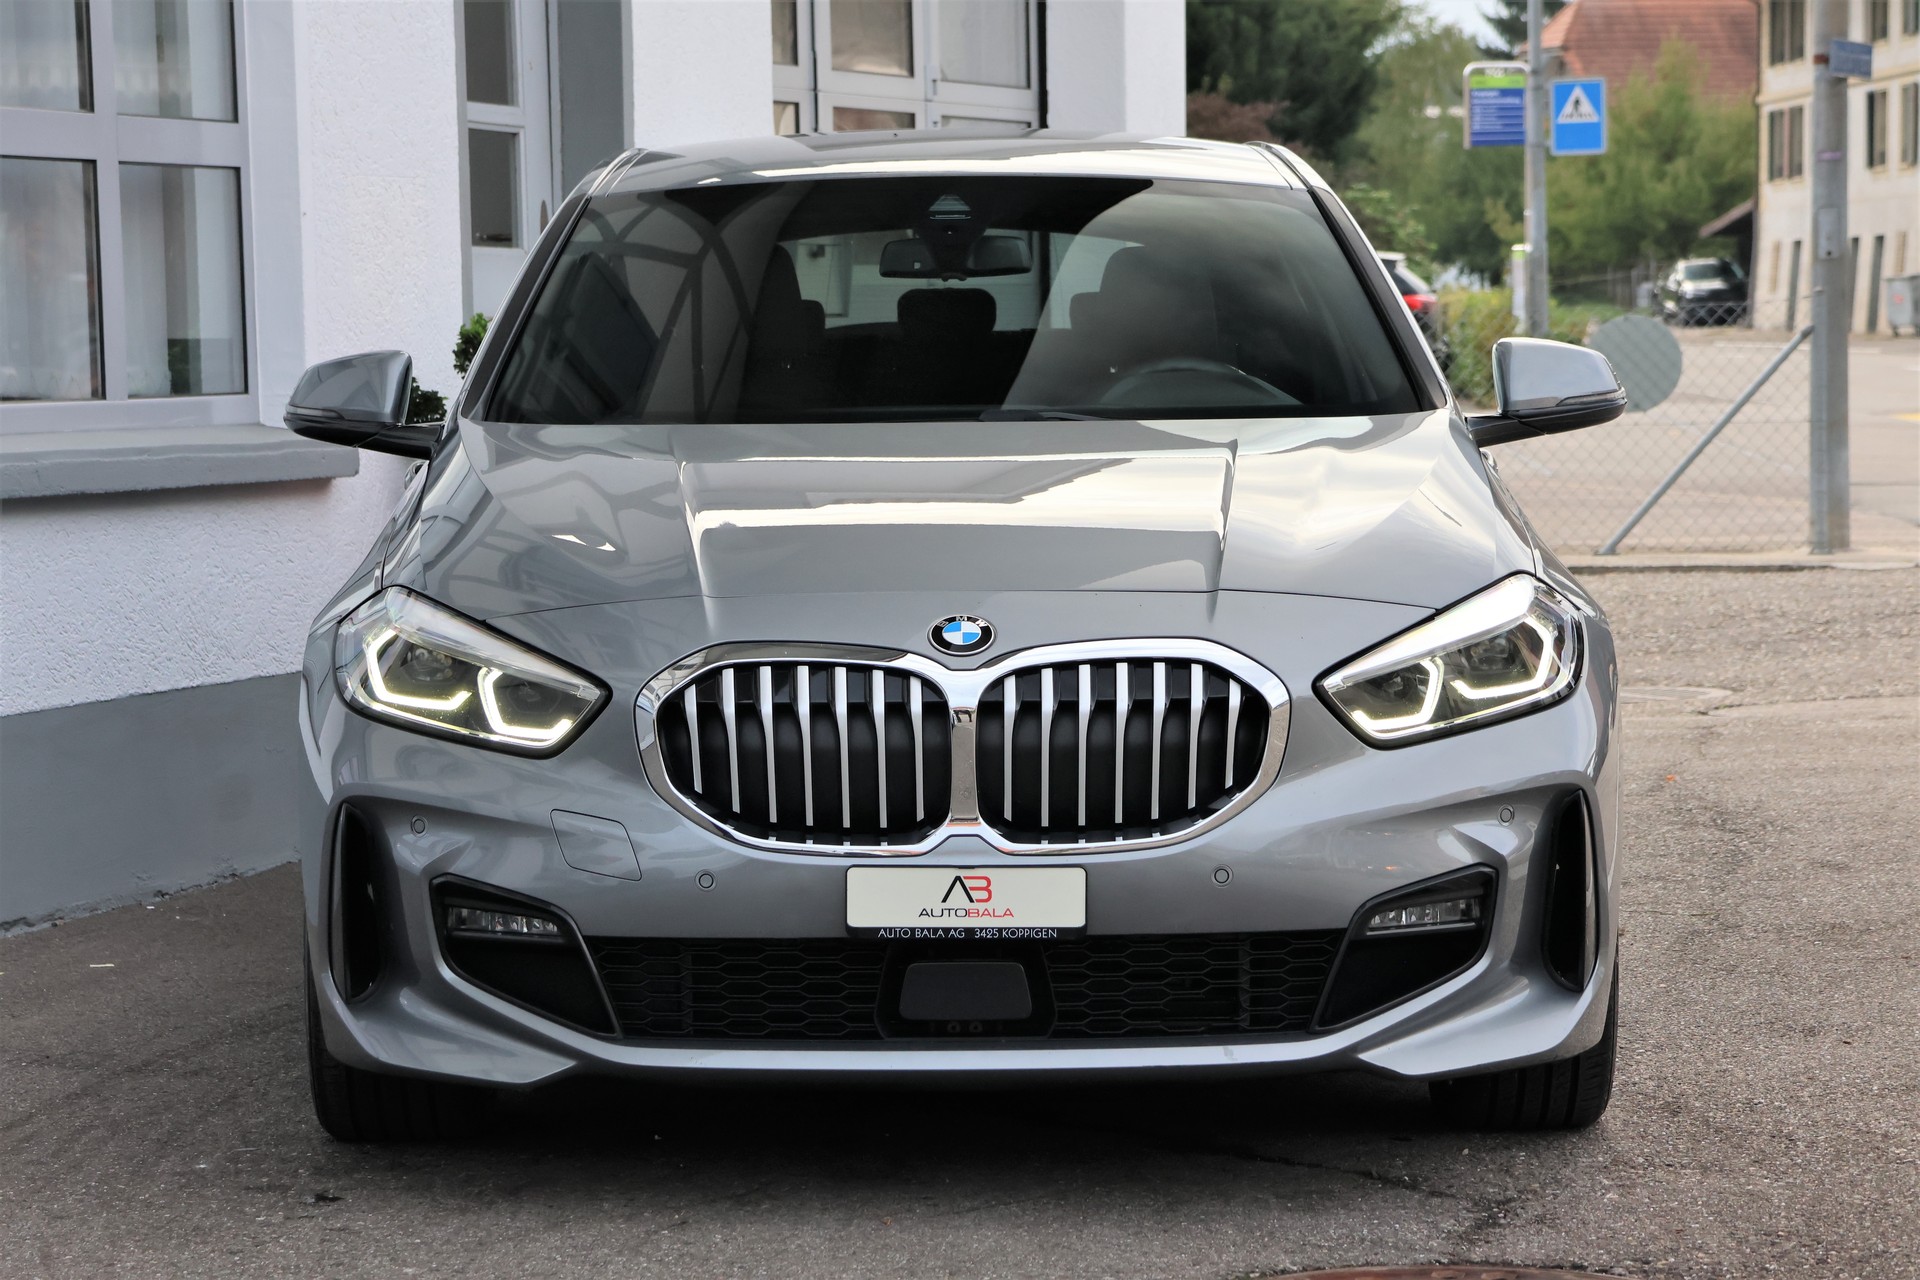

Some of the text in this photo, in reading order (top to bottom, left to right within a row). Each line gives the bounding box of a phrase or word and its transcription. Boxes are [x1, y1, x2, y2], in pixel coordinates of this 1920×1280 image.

[936, 615, 988, 627] BMW
[941, 875, 992, 903] AB
[918, 907, 1014, 918] AUTOBALA
[878, 928, 1057, 938] AUTO BALA AG 3425 KOPPIGEN
